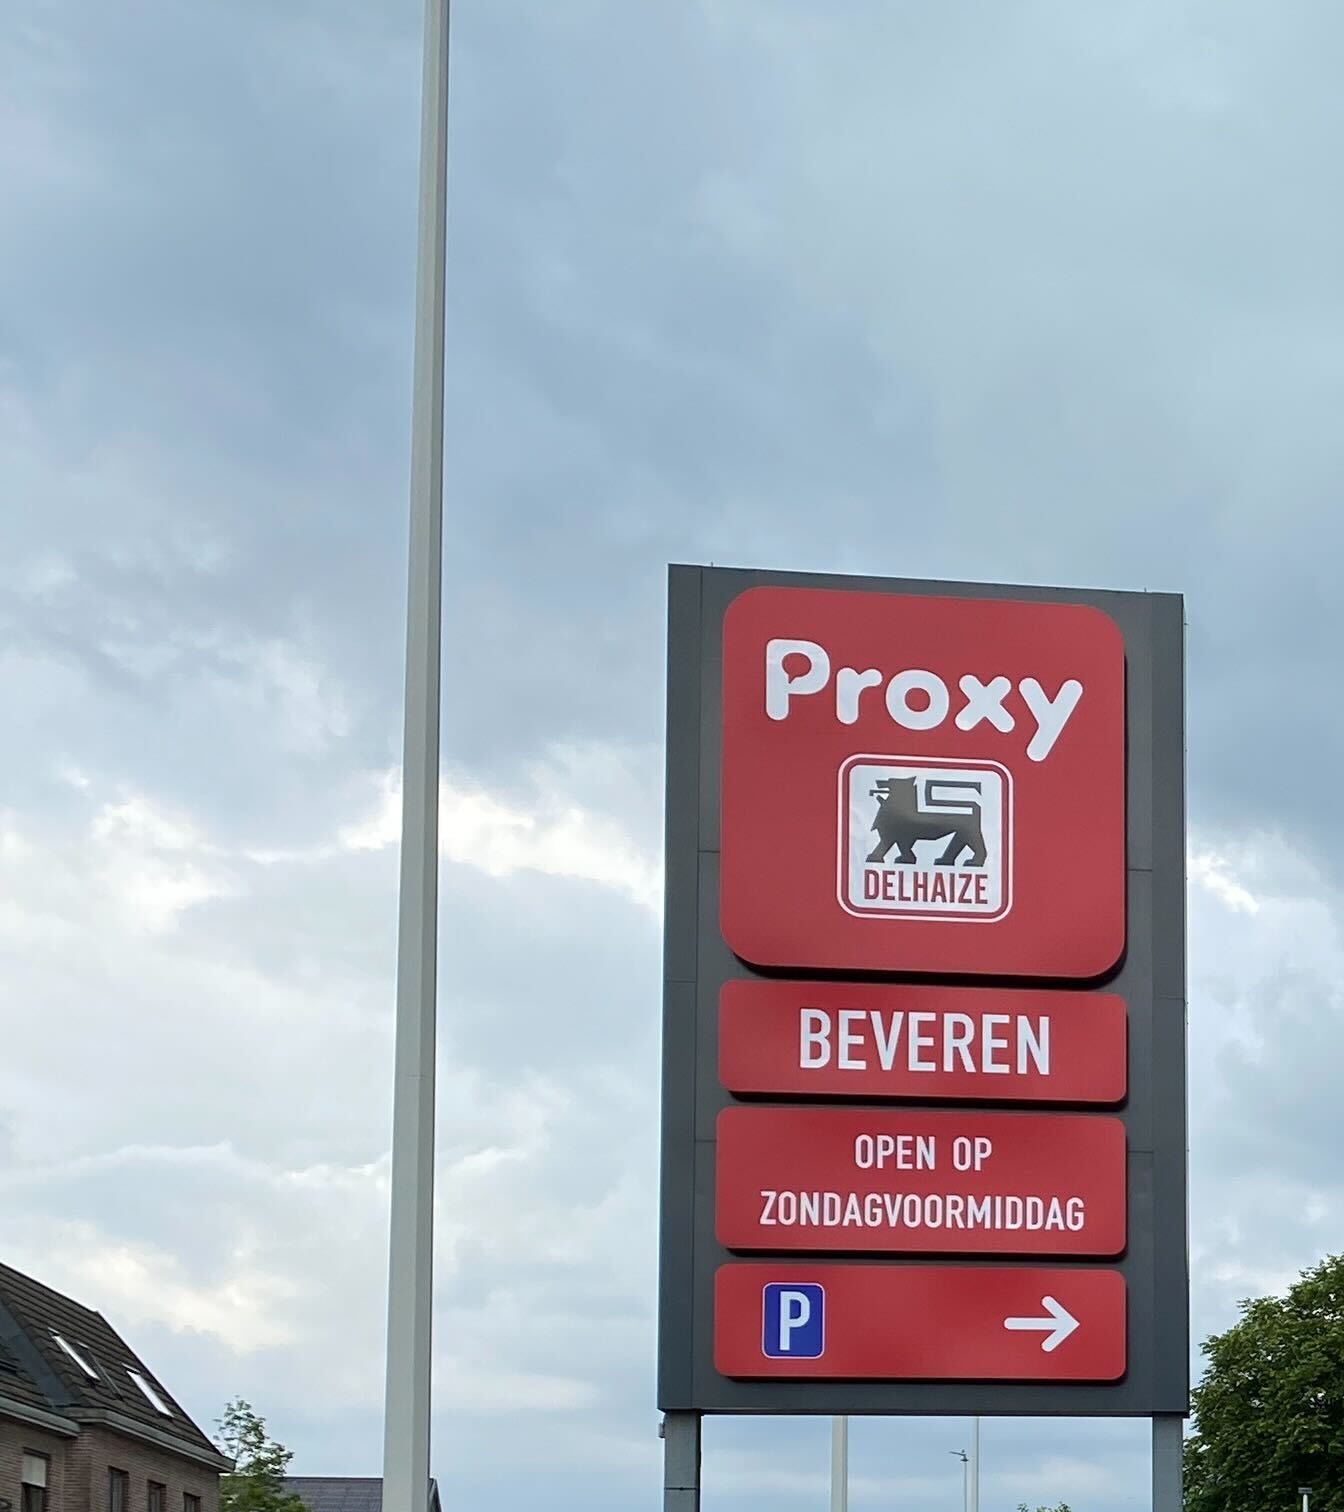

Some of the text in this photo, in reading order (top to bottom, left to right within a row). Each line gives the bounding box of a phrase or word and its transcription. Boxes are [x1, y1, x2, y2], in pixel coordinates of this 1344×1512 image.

[765, 637, 1083, 762] Proxy
[863, 868, 988, 905] DELHAIZE
[799, 1007, 1050, 1076] BEVEREN
[854, 1134, 992, 1172] OPEN OP
[759, 1190, 1085, 1232] ZONDAGVOORMIDDAG
[779, 1290, 811, 1351] P
